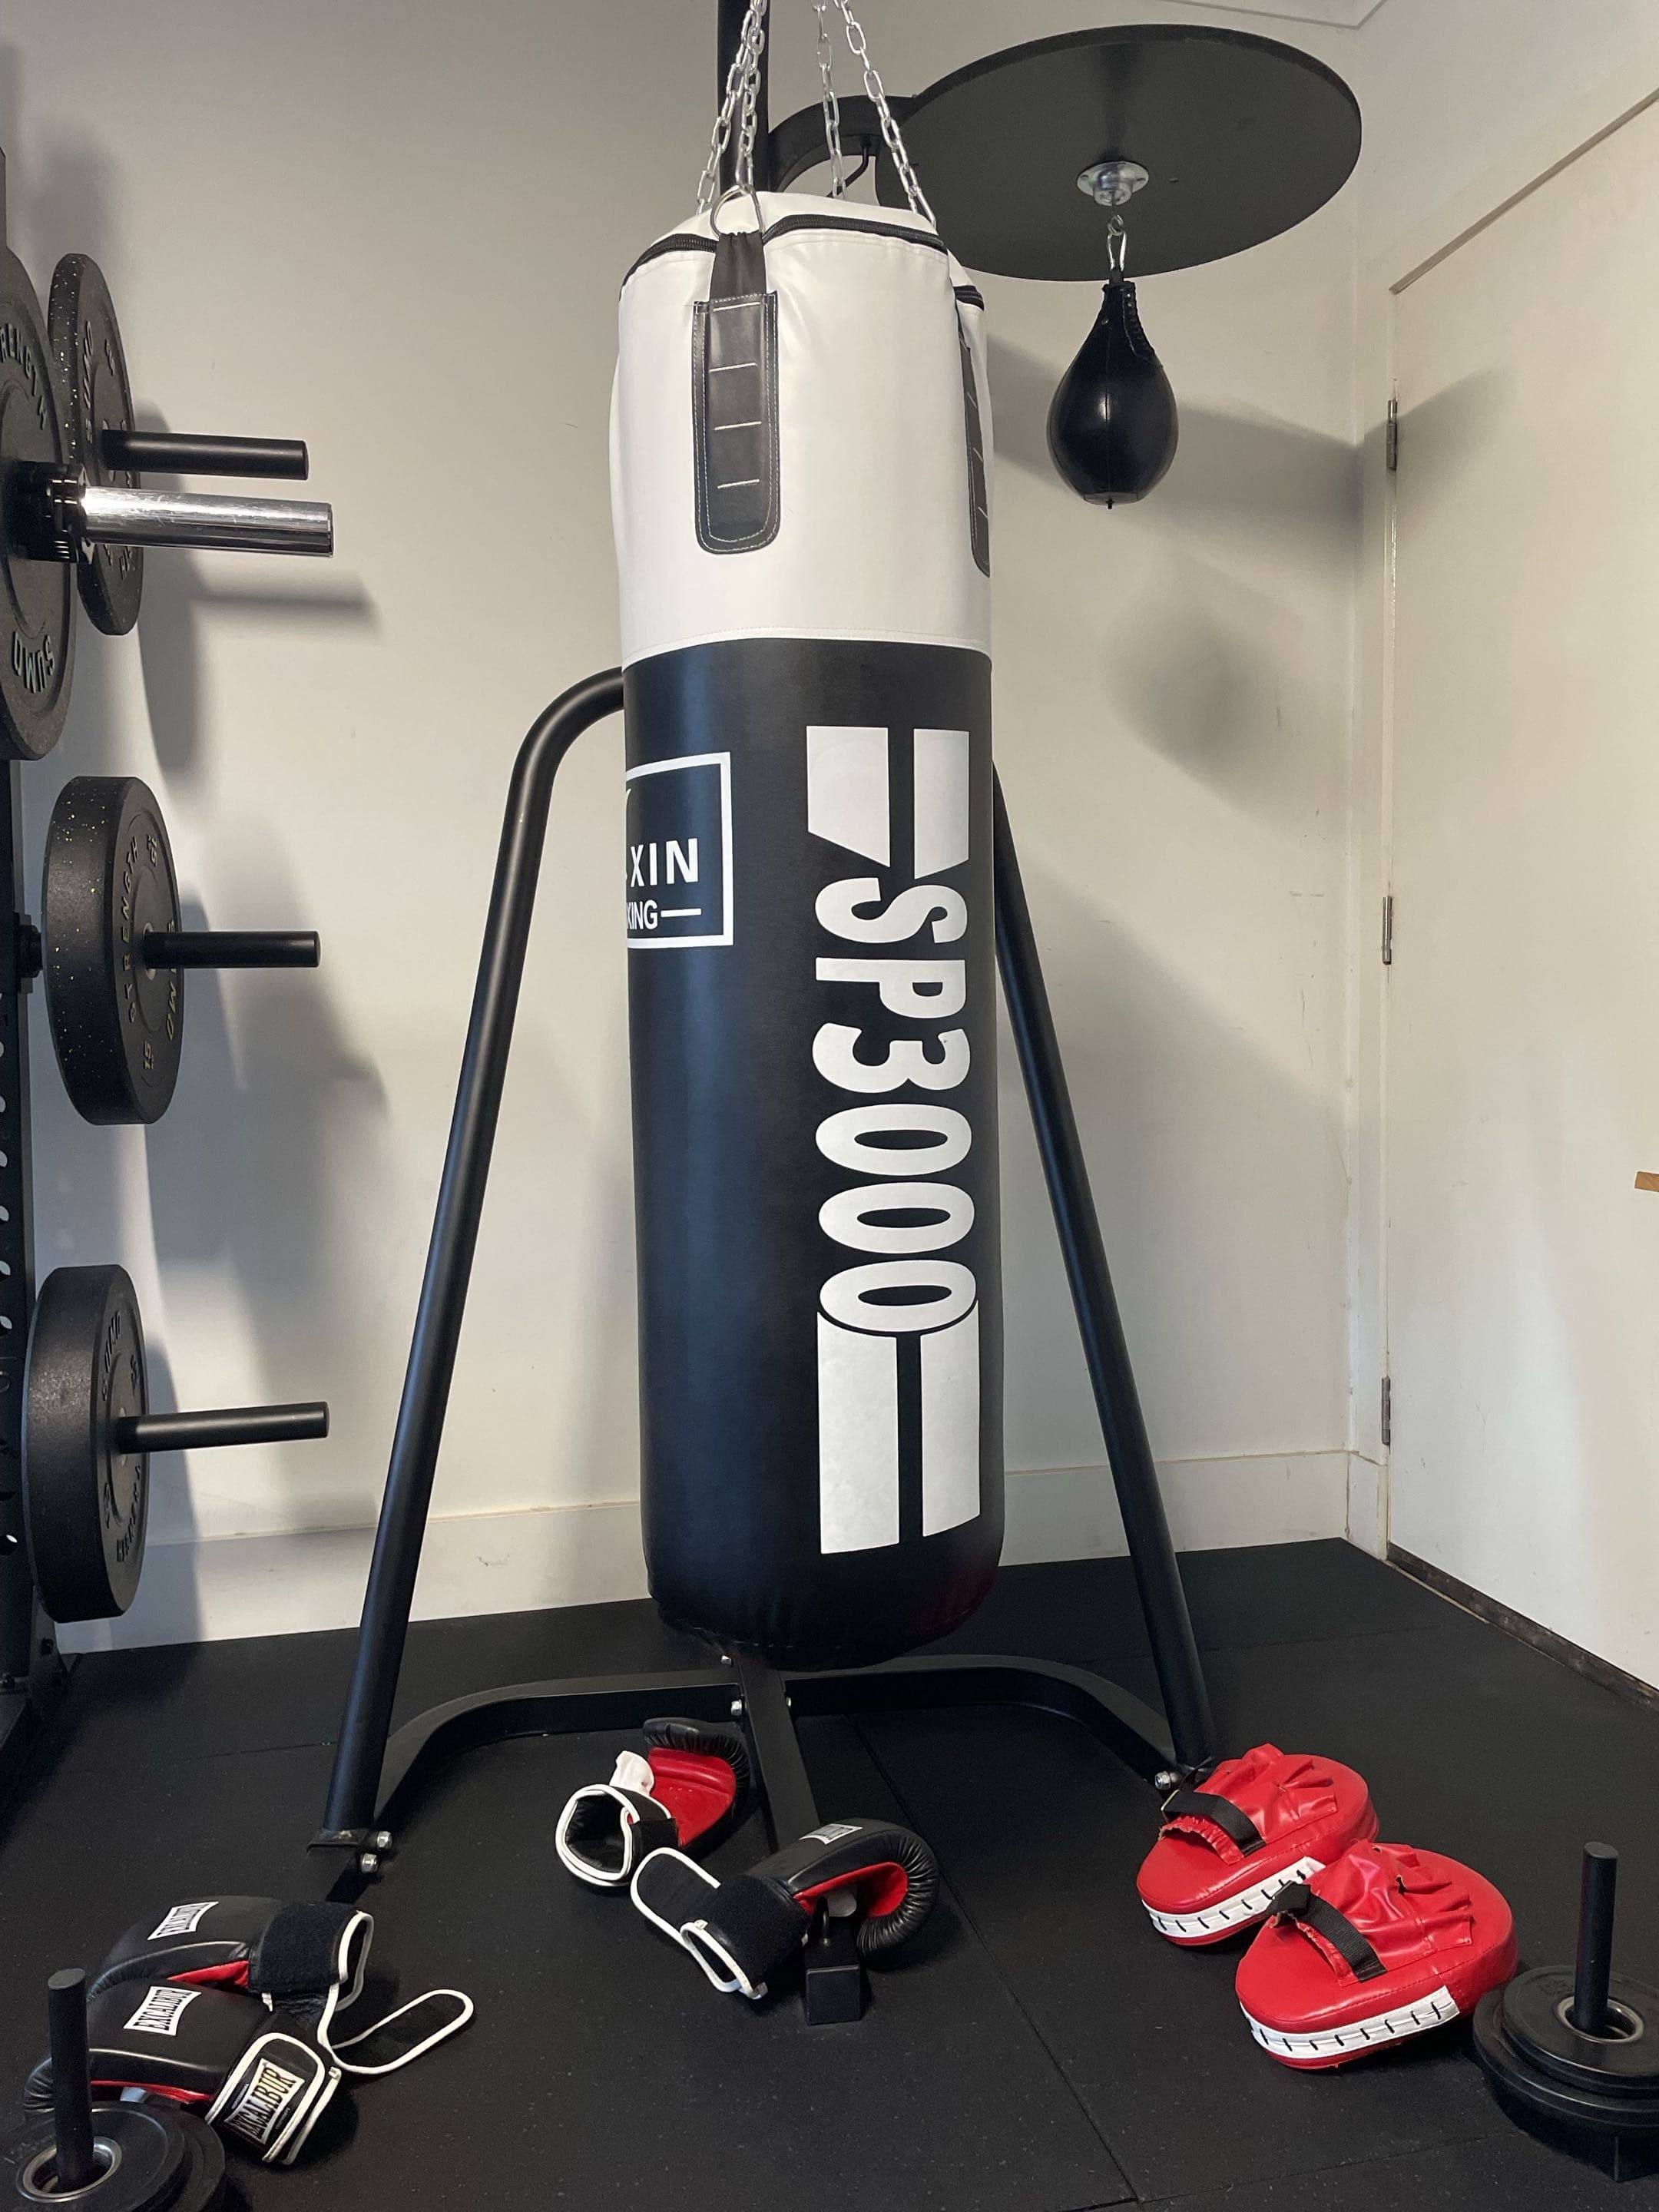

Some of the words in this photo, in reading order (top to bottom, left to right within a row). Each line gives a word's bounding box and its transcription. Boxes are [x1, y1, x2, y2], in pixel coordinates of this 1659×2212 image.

[12, 631, 55, 694] SUMO
[626, 838, 699, 888] XIN
[121, 836, 139, 1023] STRENGTH
[812, 877, 976, 1333] SP3000
[133, 1989, 194, 2031] EXCALIBUR
[230, 2066, 297, 2140] EXCALIBUR
